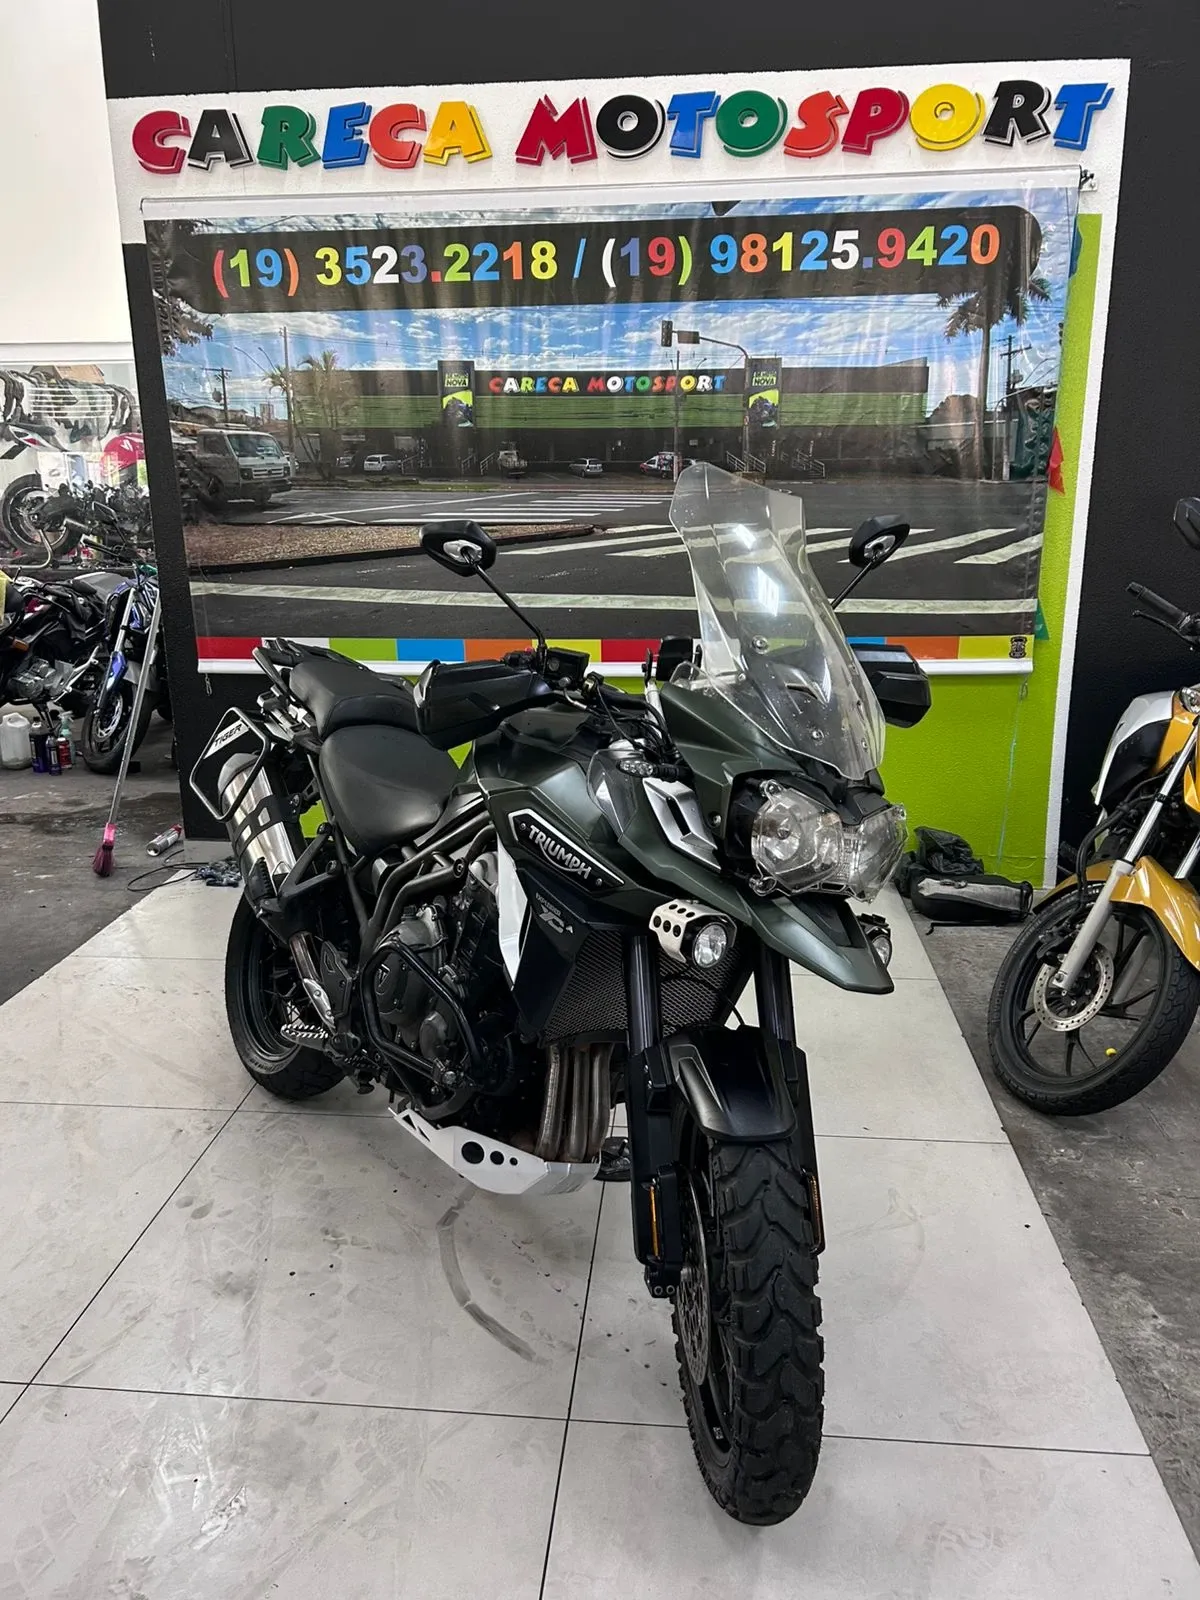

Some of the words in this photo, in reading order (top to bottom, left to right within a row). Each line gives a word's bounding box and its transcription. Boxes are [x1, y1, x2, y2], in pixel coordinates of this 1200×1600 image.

[132, 101, 492, 175] CARECA
[515, 80, 1114, 168] MOTOSPORT
[212, 247, 299, 298] (19)
[315, 239, 558, 285] 3523.2218
[572, 238, 586, 279] /
[601, 234, 693, 289] (19)
[709, 223, 1001, 274] 98125.9420
[488, 375, 580, 394] CARECA
[587, 374, 726, 394] MOTOSPORT
[213, 722, 243, 747] TIGER
[527, 823, 593, 880] TRIUMPH
